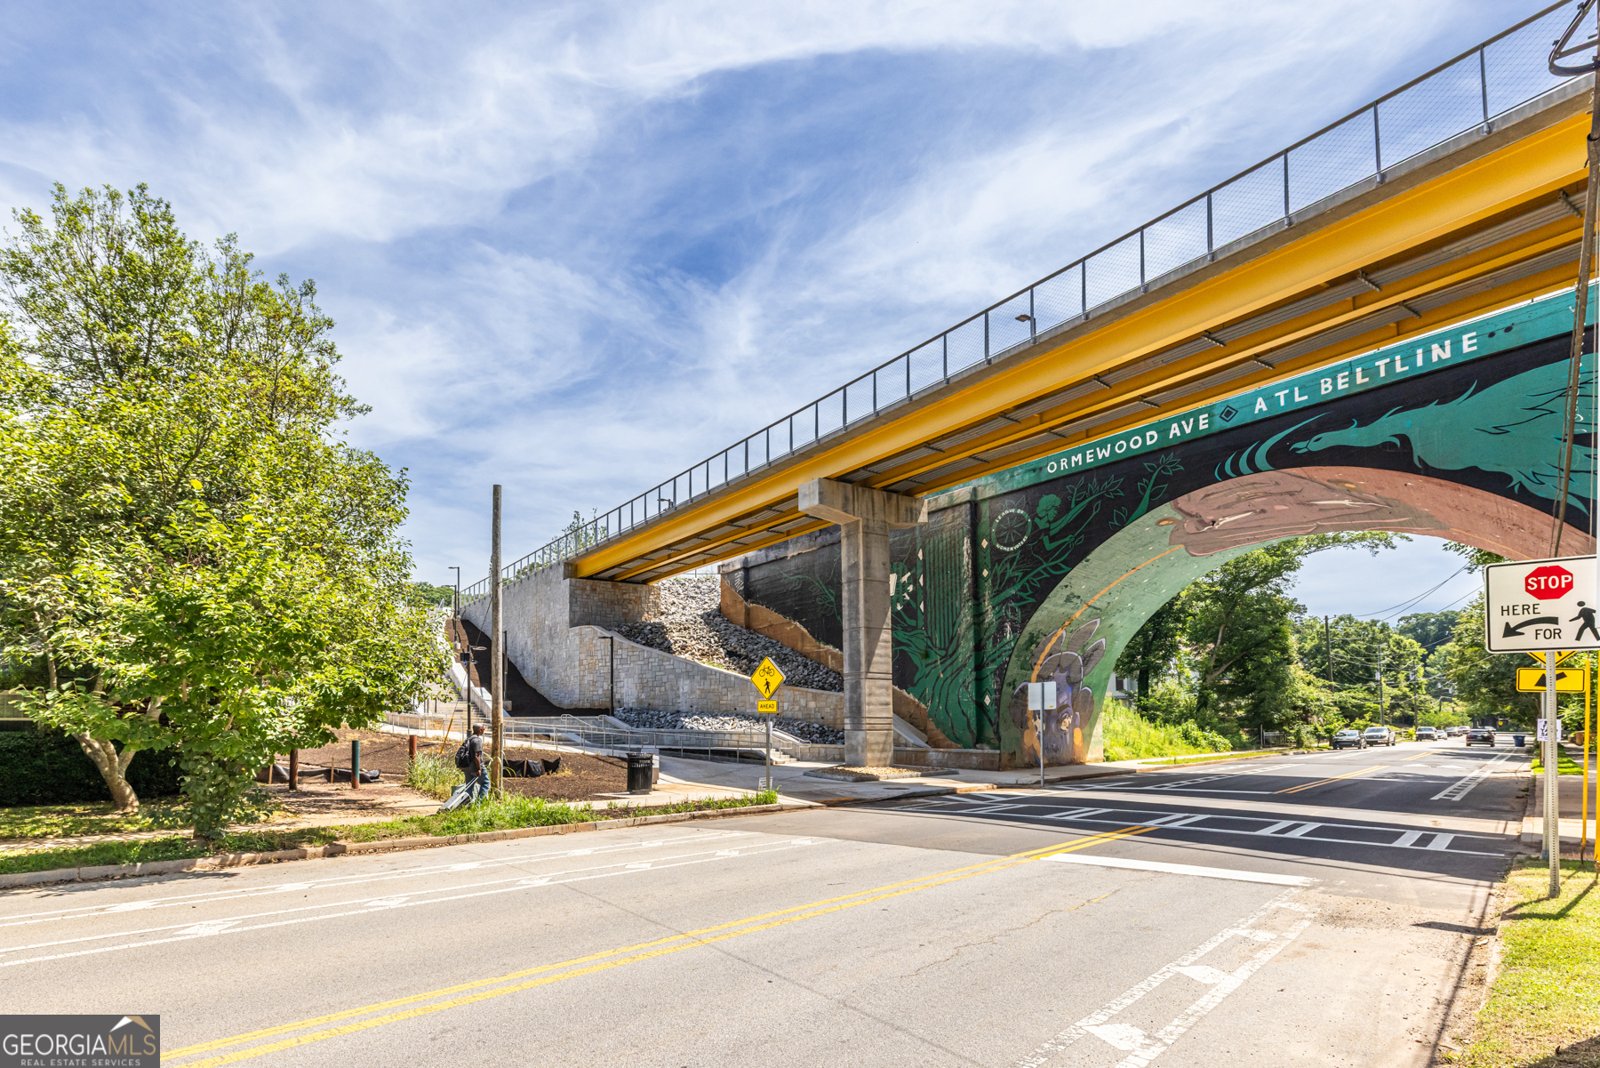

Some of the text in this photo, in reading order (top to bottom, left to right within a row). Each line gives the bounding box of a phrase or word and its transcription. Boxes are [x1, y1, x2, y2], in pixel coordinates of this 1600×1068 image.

[1254, 331, 1478, 414] ATL BELTLINE
[1047, 413, 1209, 473] ORMEWOOD AVE
[1527, 575, 1573, 591] STOP
[1500, 603, 1541, 616] HERE
[1535, 628, 1562, 640] FOR
